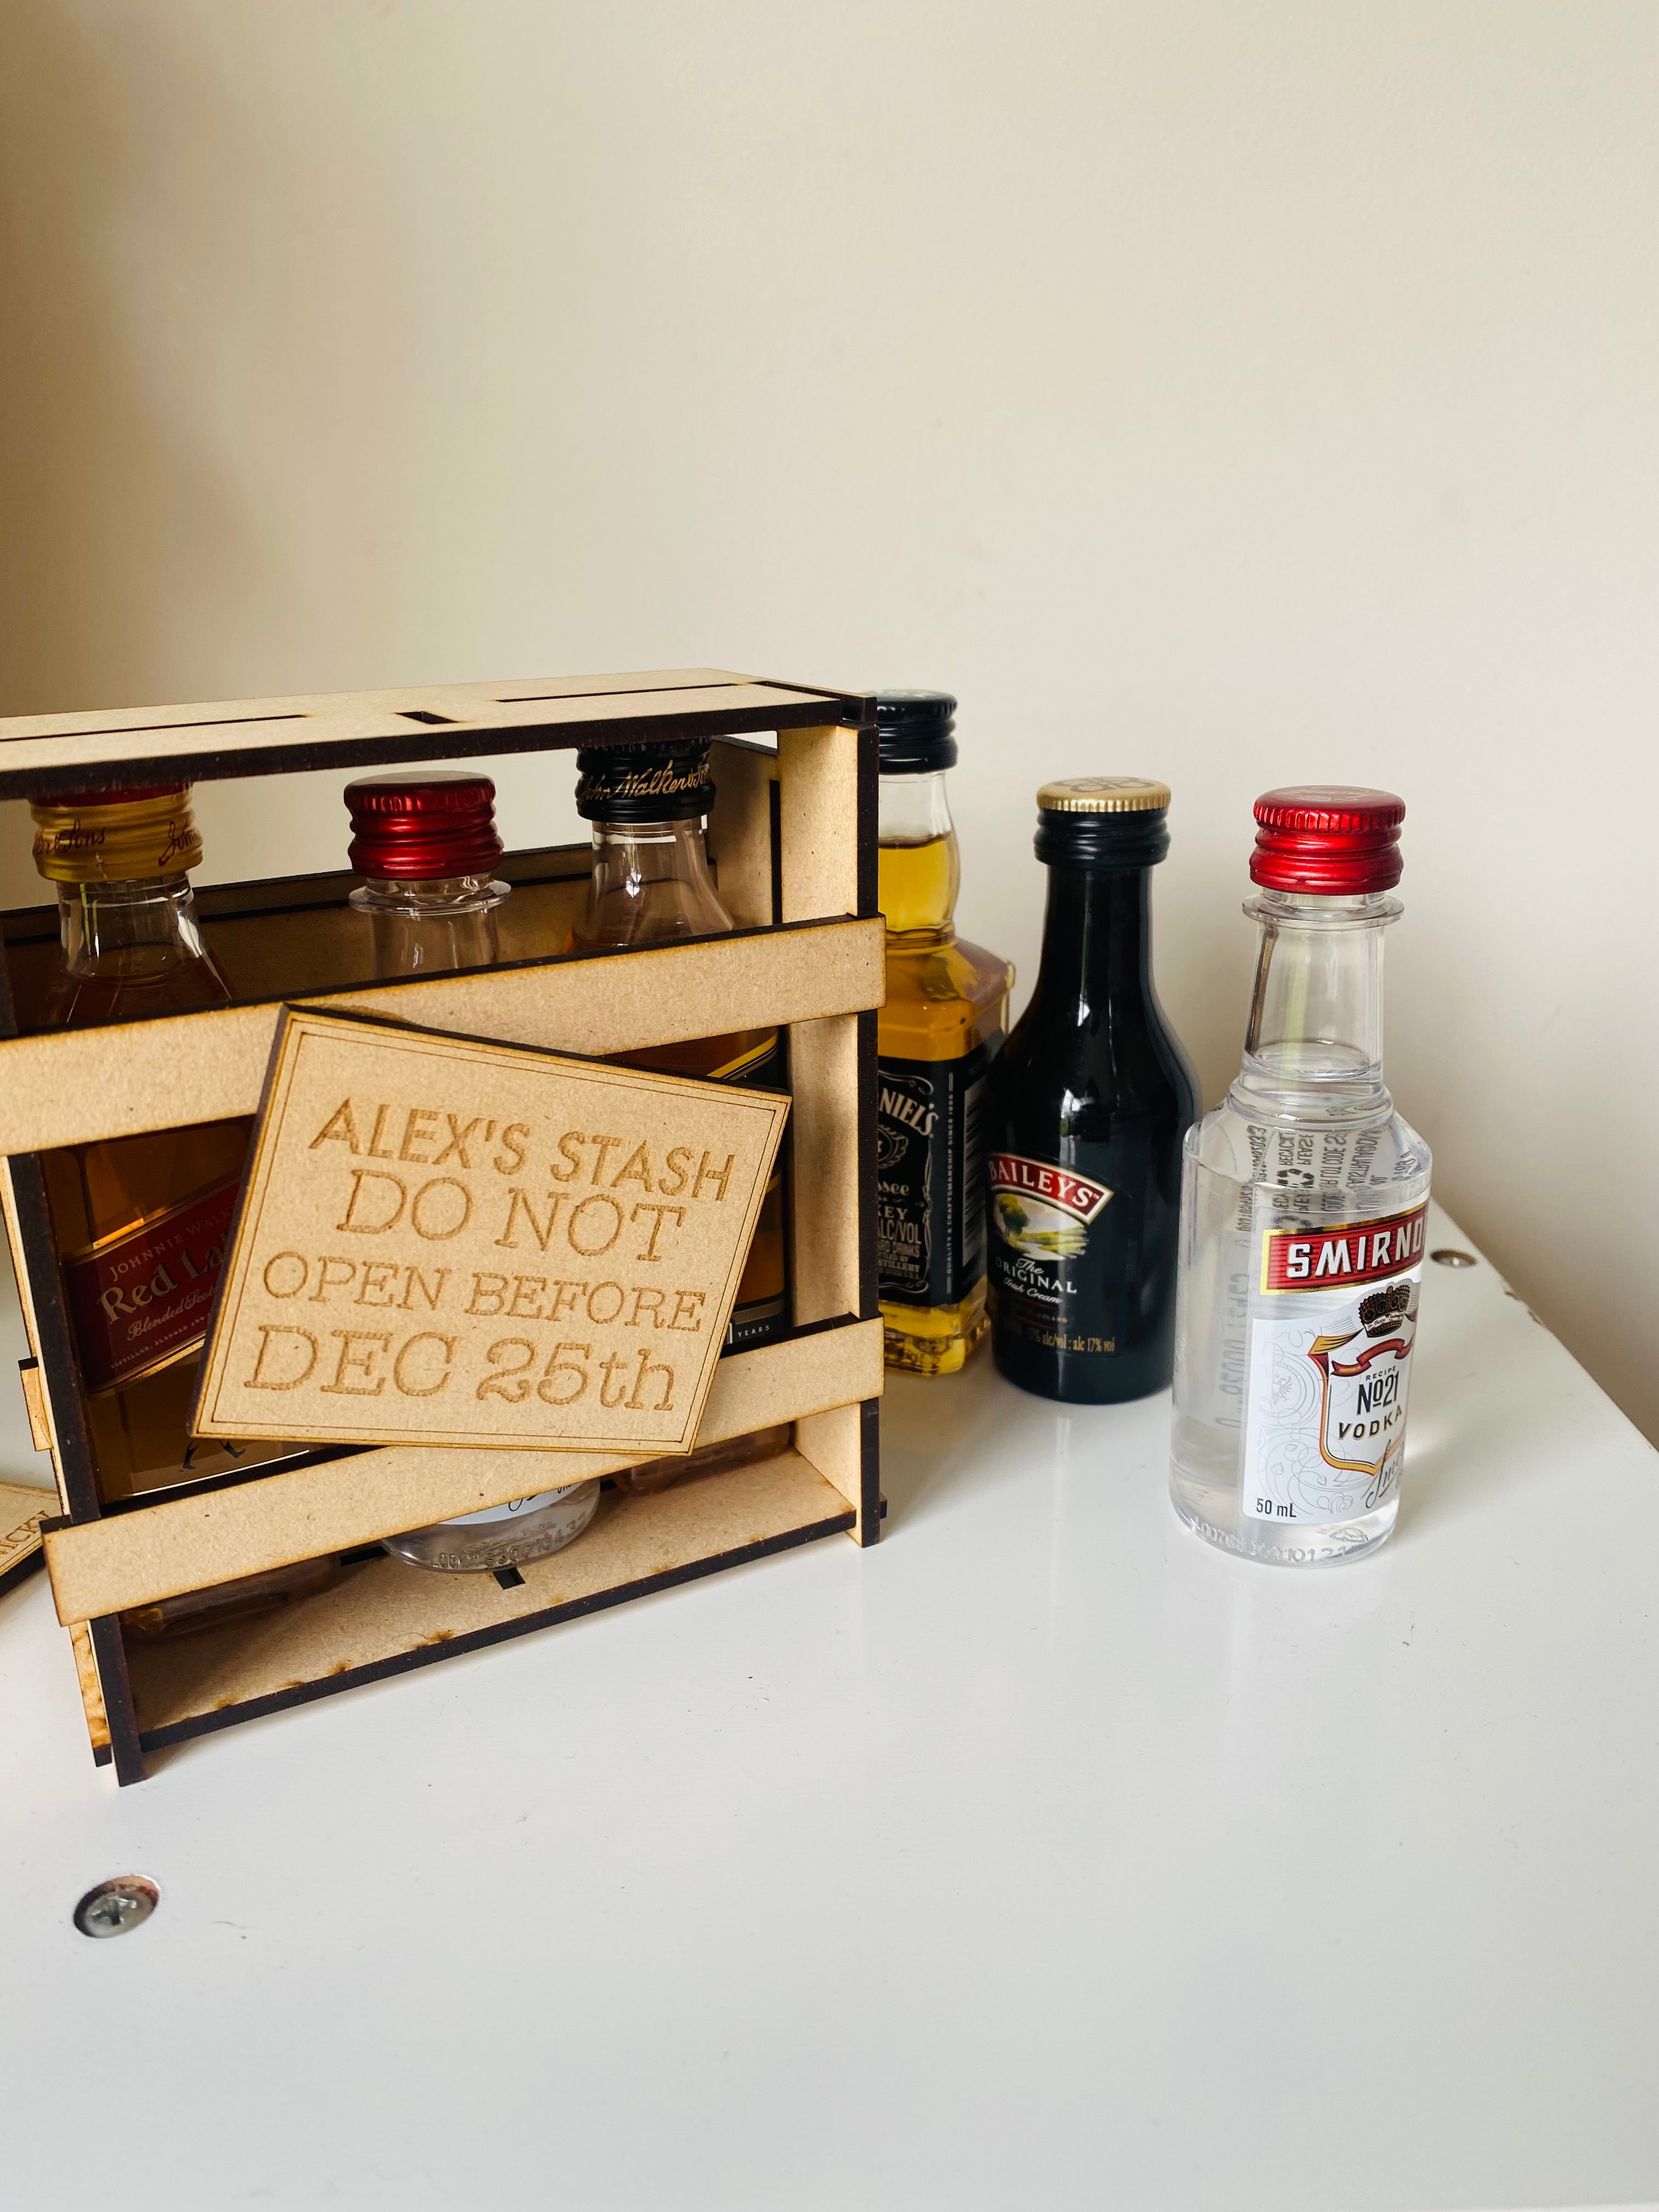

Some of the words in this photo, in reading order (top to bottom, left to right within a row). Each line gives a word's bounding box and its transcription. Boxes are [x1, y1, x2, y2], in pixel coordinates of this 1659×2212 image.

[615, 759, 687, 798] Walker
[309, 1097, 531, 1176] ALEX'S
[550, 1130, 736, 1201] STASH
[988, 1160, 1094, 1207] BAILEYS
[336, 1168, 473, 1240] DO
[495, 1187, 686, 1262] NOT
[878, 1204, 909, 1220] EY
[878, 1218, 922, 1245] LC/VOL
[109, 1233, 185, 1282] JOHNNIE
[185, 1206, 233, 1235] WALK
[1286, 1216, 1427, 1279] SMIRNO
[996, 1257, 1077, 1295] ORIGINAL
[1015, 1258, 1044, 1274] The
[96, 1262, 178, 1324] Red
[263, 1251, 452, 1311] OPEN
[465, 1271, 706, 1332] BEFORE
[1027, 1288, 1063, 1305] Cream
[127, 1295, 186, 1341] Blended
[737, 1324, 770, 1338] YEARS
[244, 1324, 461, 1397] DEC
[476, 1338, 674, 1410] 25th
[1365, 1365, 1396, 1381] RECIPE
[1338, 1404, 1403, 1440] VODKA
[1256, 1498, 1272, 1515] 50
[1277, 1502, 1297, 1519] mL
